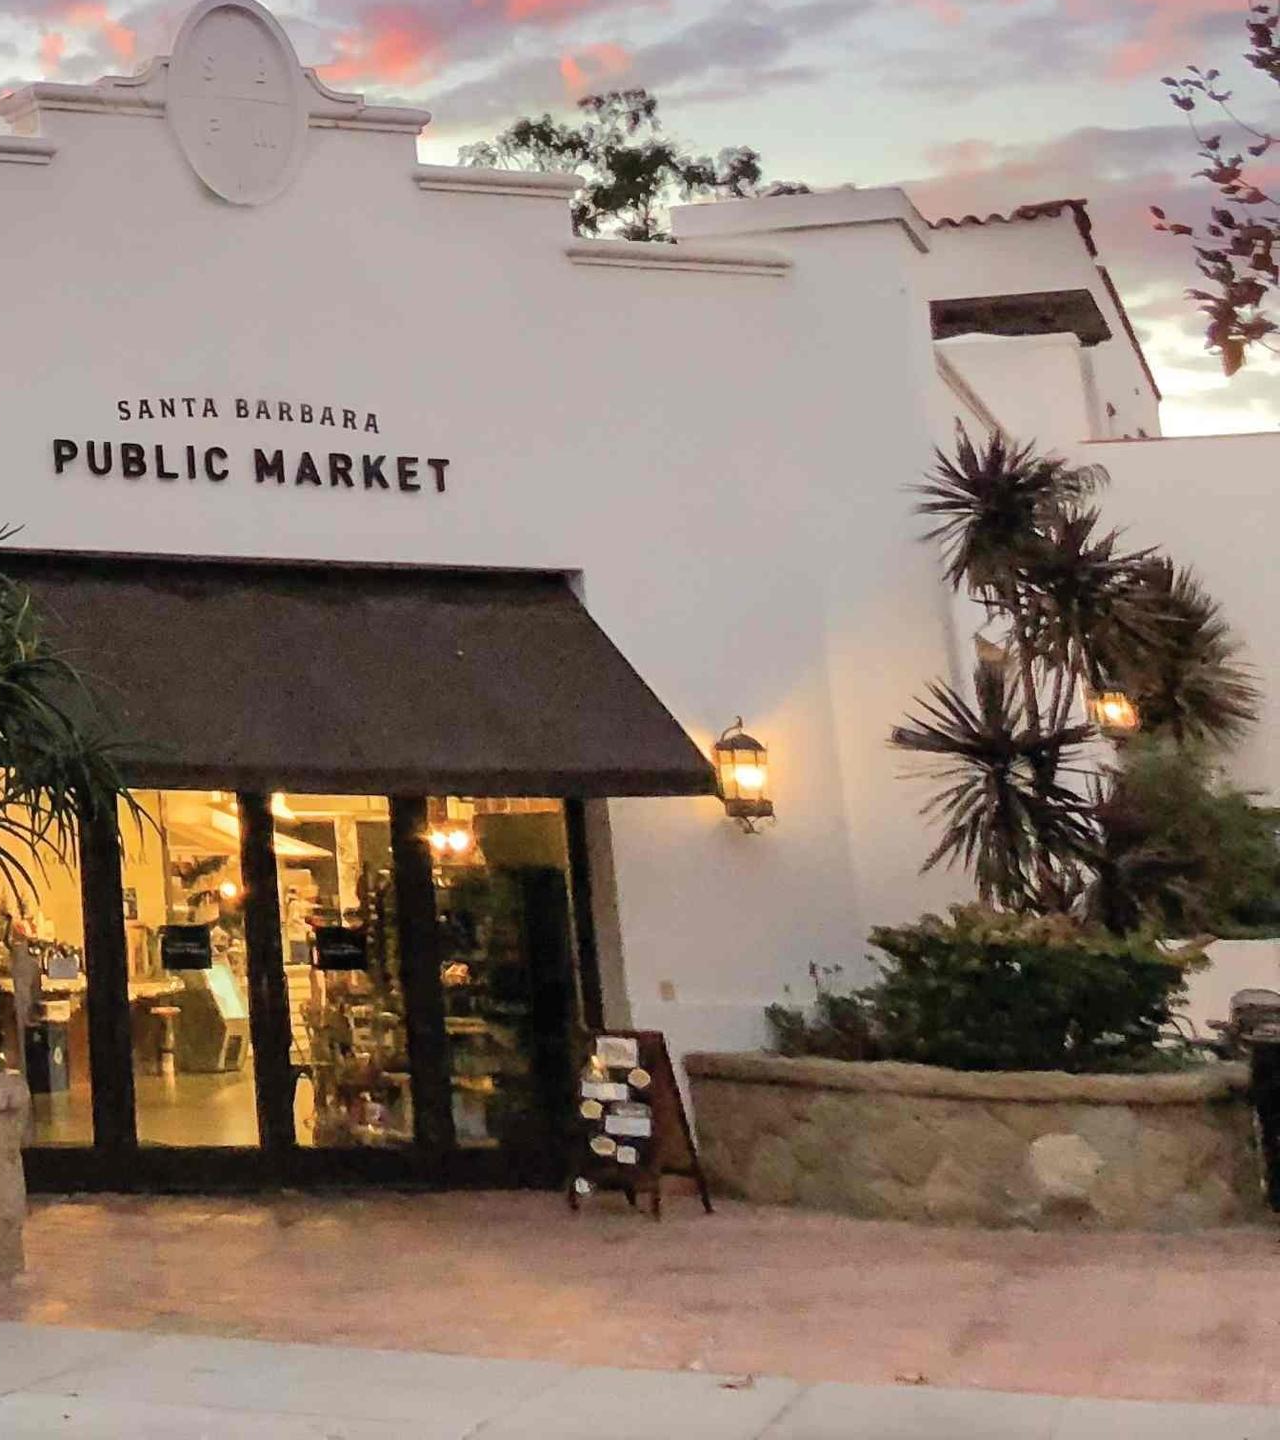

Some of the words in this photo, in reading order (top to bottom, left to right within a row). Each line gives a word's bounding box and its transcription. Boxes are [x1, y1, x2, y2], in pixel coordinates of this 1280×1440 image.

[117, 398, 218, 422] SANTA
[235, 398, 380, 435] BARBARA
[52, 439, 229, 482] PUBLIC
[253, 448, 451, 493] MARKET
